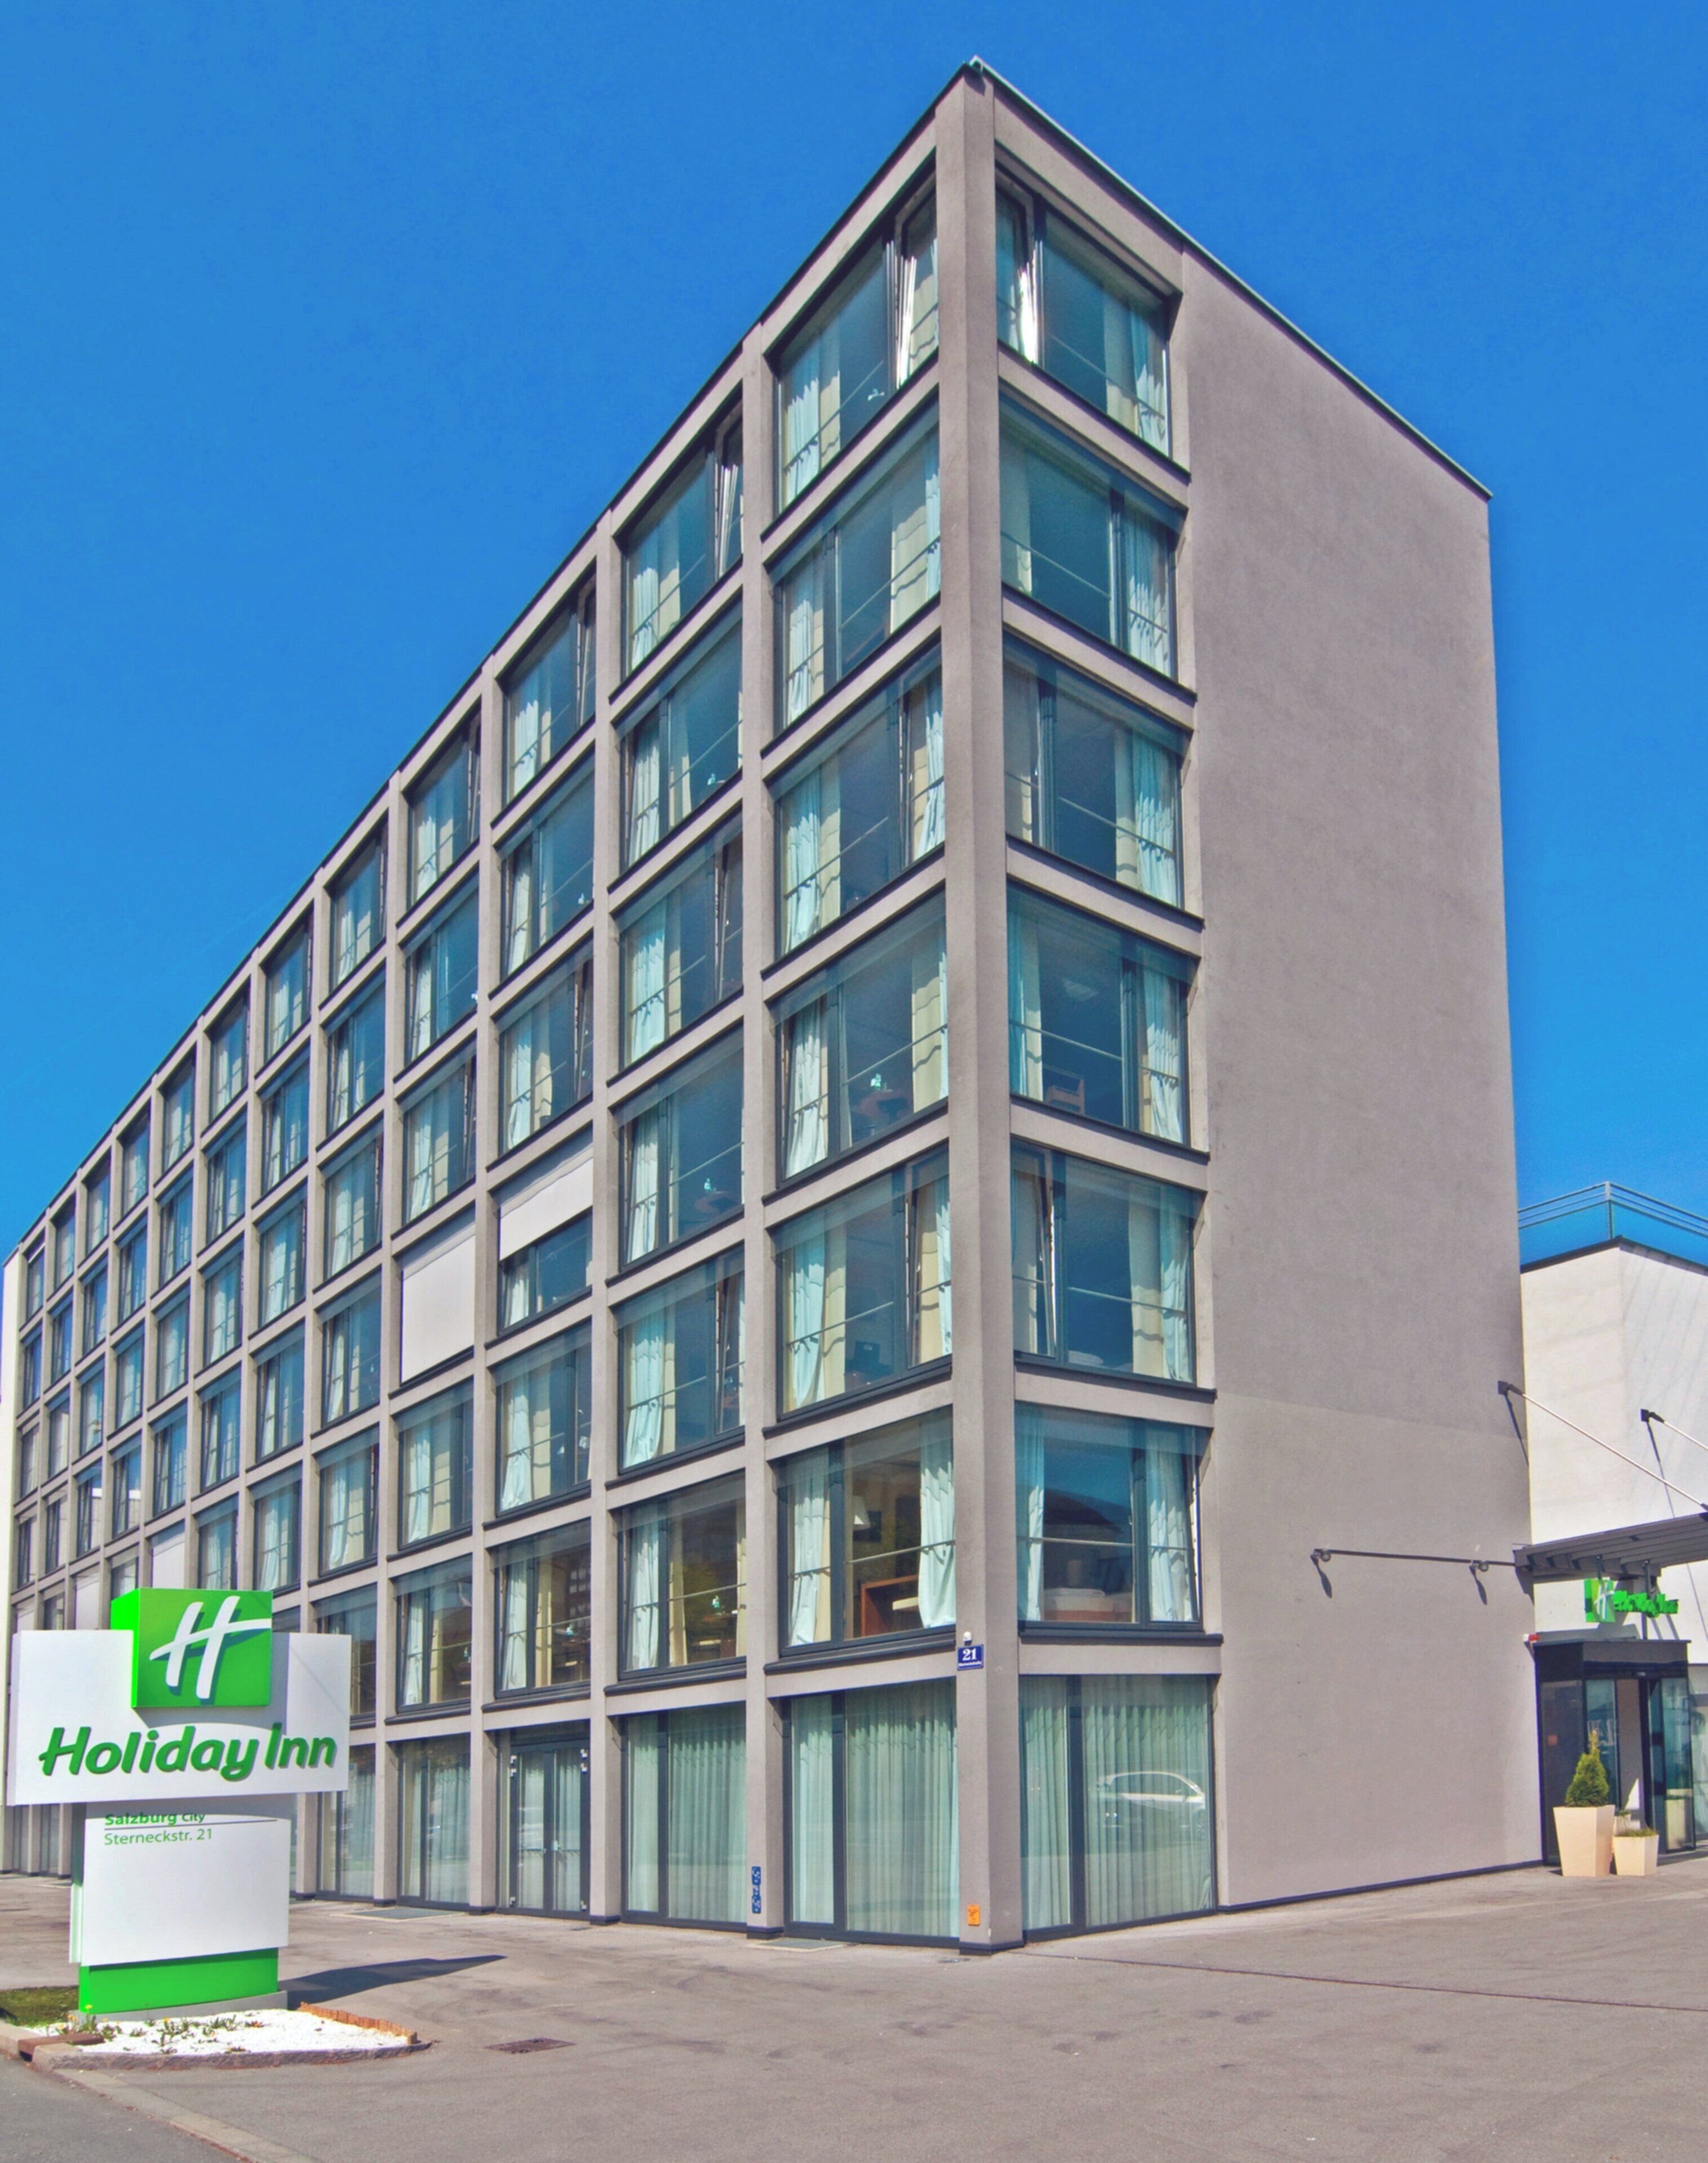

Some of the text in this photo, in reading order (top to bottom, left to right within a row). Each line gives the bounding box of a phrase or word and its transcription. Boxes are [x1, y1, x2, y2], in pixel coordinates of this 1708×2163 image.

[962, 1648, 977, 1661] 21
[37, 1723, 338, 1782] Holiday Inn
[105, 1812, 177, 1826] Salzburg
[104, 1828, 212, 1845] Sterneckstr. 21
